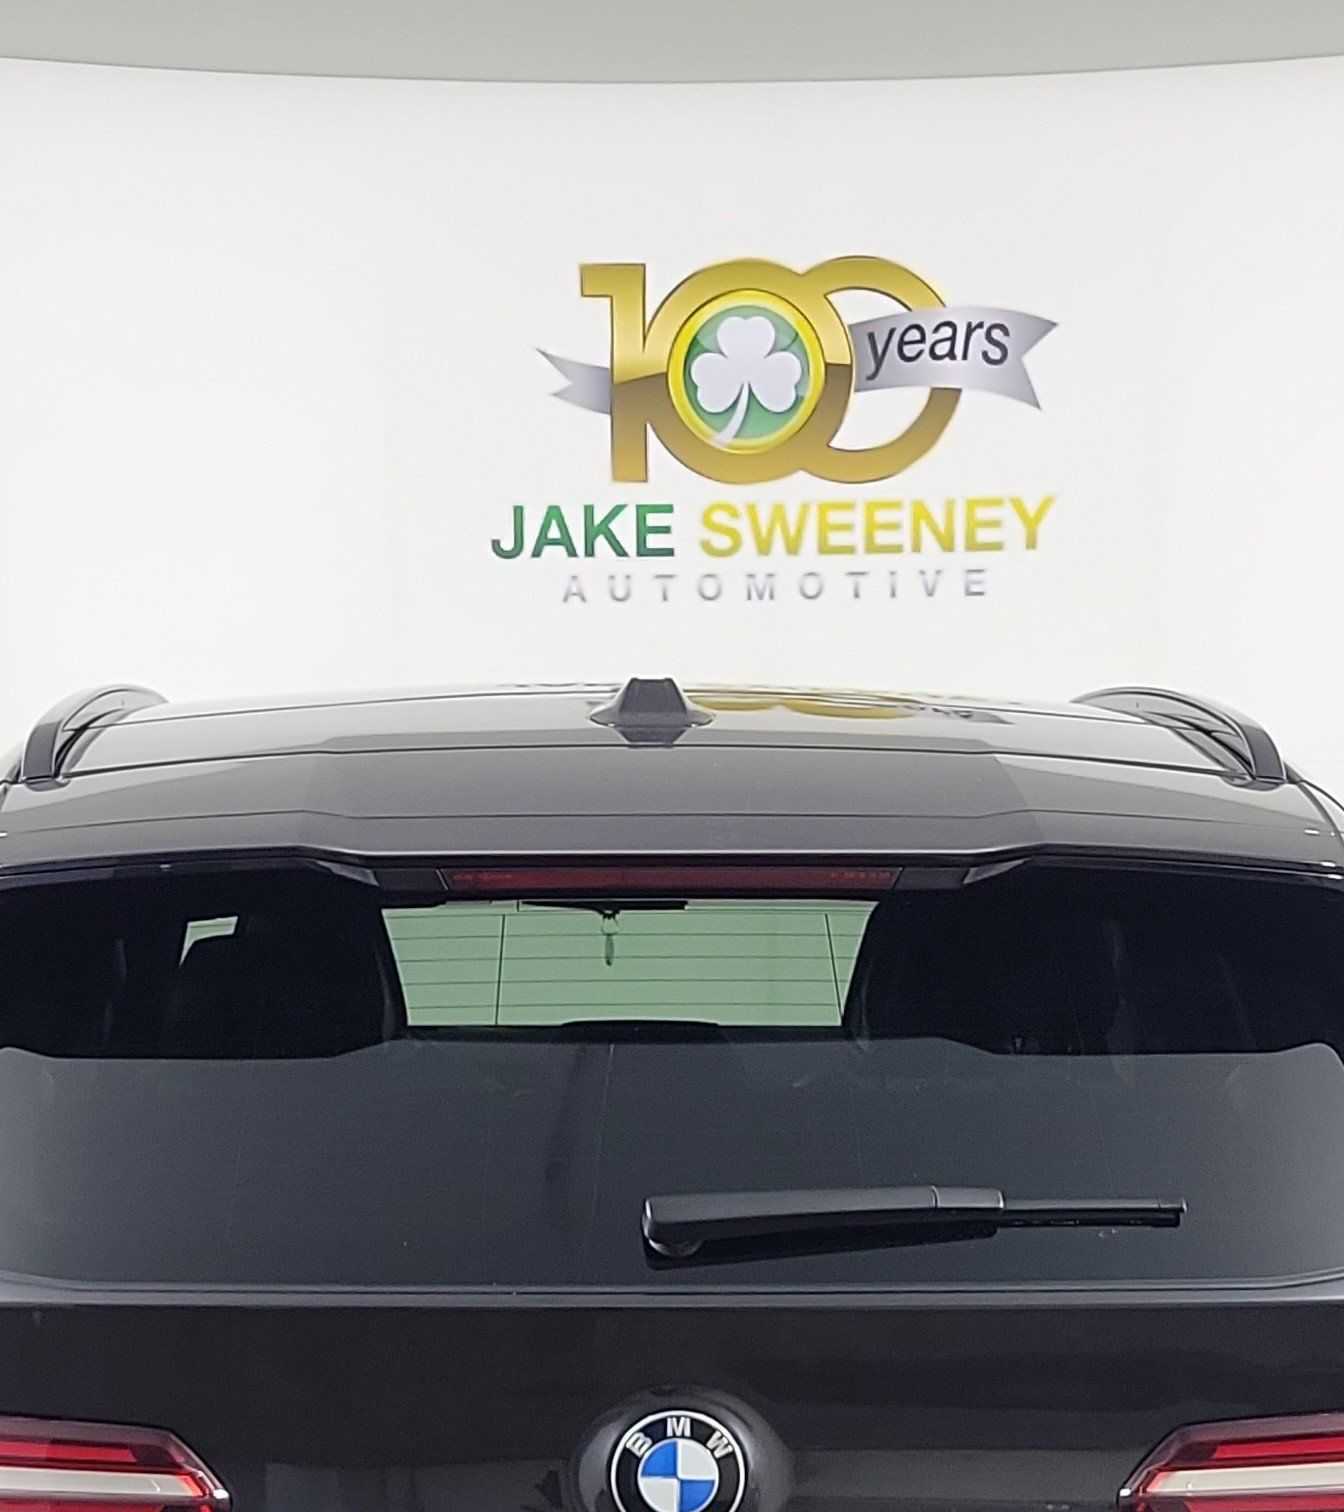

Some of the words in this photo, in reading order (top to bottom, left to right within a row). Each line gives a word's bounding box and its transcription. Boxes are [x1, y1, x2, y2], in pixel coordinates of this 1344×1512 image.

[864, 319, 1012, 381] years
[490, 503, 676, 560] JAKE
[698, 494, 1058, 558] SWEENEY
[562, 568, 988, 605] AUTOMOTIVE
[625, 1416, 734, 1459] BMW
